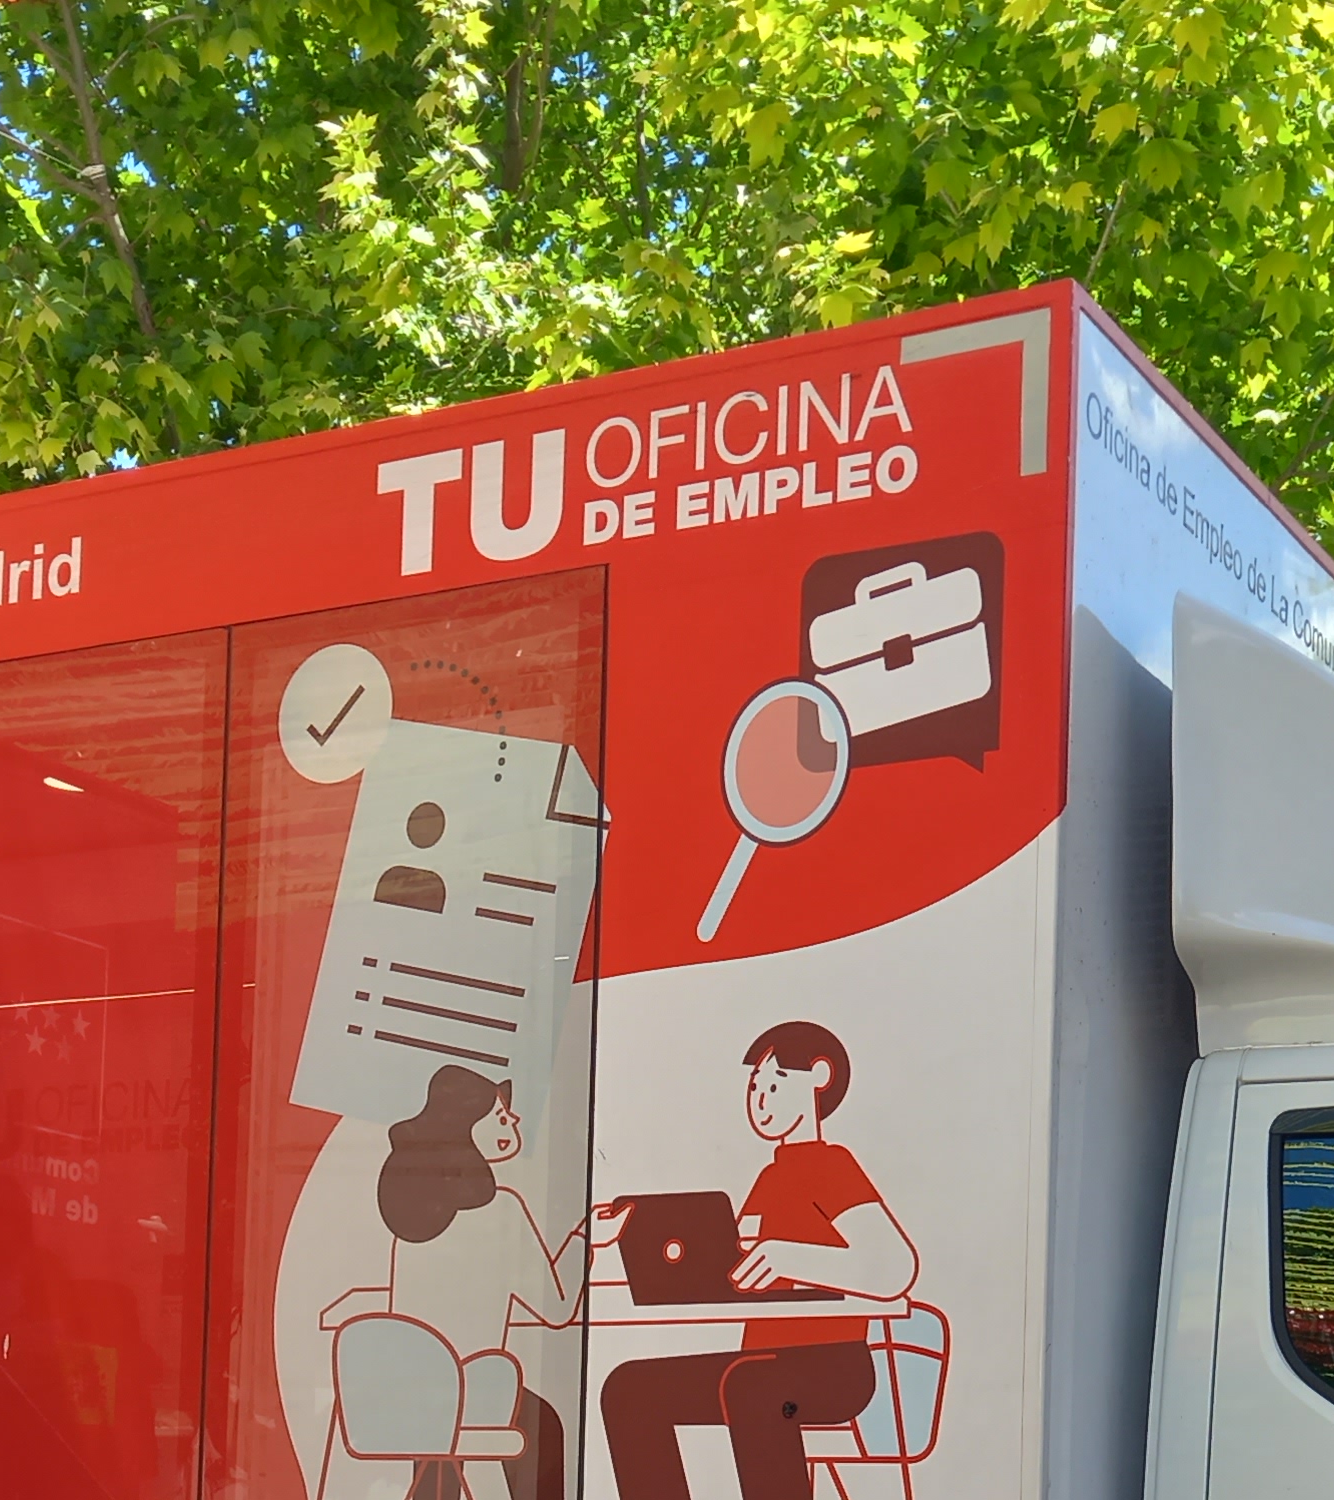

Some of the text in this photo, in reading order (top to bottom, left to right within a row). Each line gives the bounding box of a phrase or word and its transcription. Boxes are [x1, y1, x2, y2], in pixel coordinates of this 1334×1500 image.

[376, 364, 913, 577] TU OFICINA
[582, 445, 918, 546] DE EMPLEO
[1086, 392, 1151, 491] Oficina
[1156, 464, 1178, 515] de
[1182, 485, 1243, 580] Empleo
[1247, 557, 1266, 603] de
[1270, 575, 1288, 627] La
